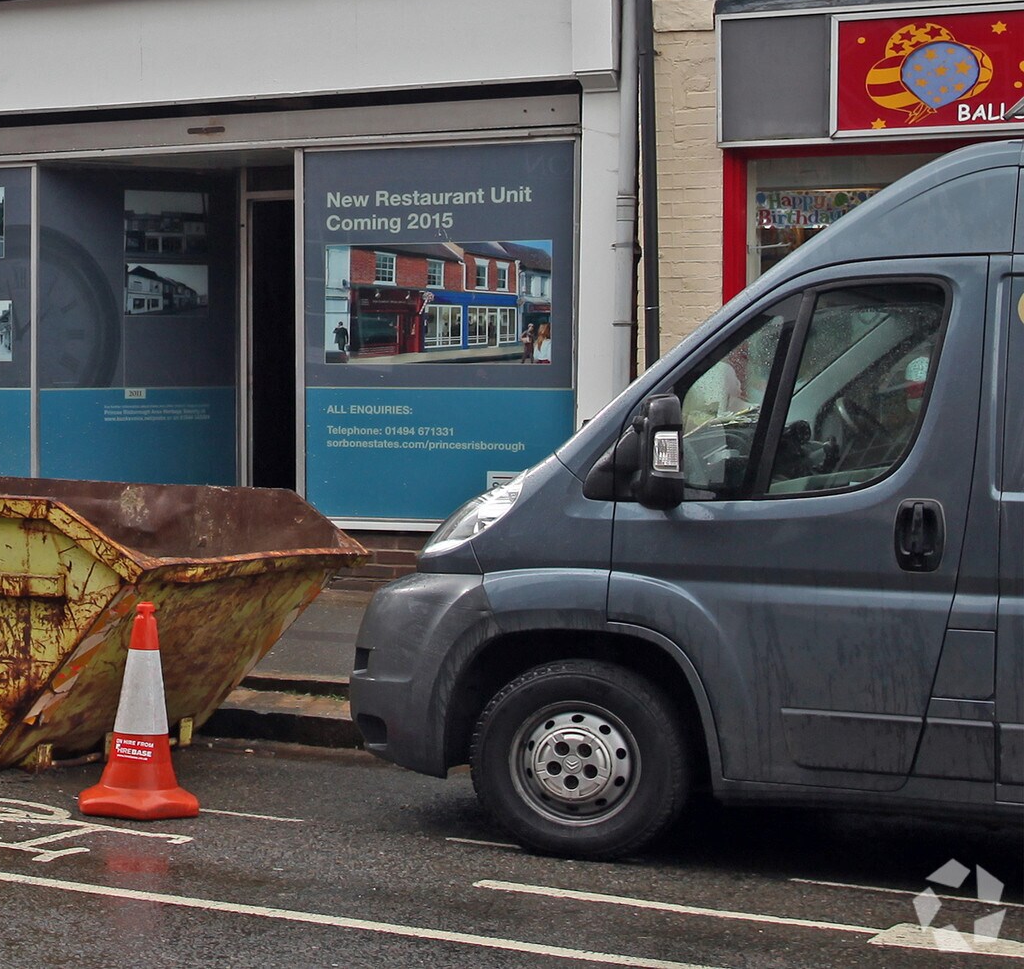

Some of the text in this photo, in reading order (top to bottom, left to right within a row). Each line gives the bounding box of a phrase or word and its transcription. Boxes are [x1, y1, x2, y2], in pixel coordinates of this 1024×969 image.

[327, 185, 532, 208] New Restaurant Unit
[768, 192, 826, 211] Happy
[326, 212, 453, 234] Coming 2015
[326, 405, 413, 415] ALL ENQUIRIES:
[327, 425, 454, 437] Telephone: 01494 671331
[326, 438, 525, 453] sorbonestates.com/princesrisborough
[137, 740, 154, 748] FROM
